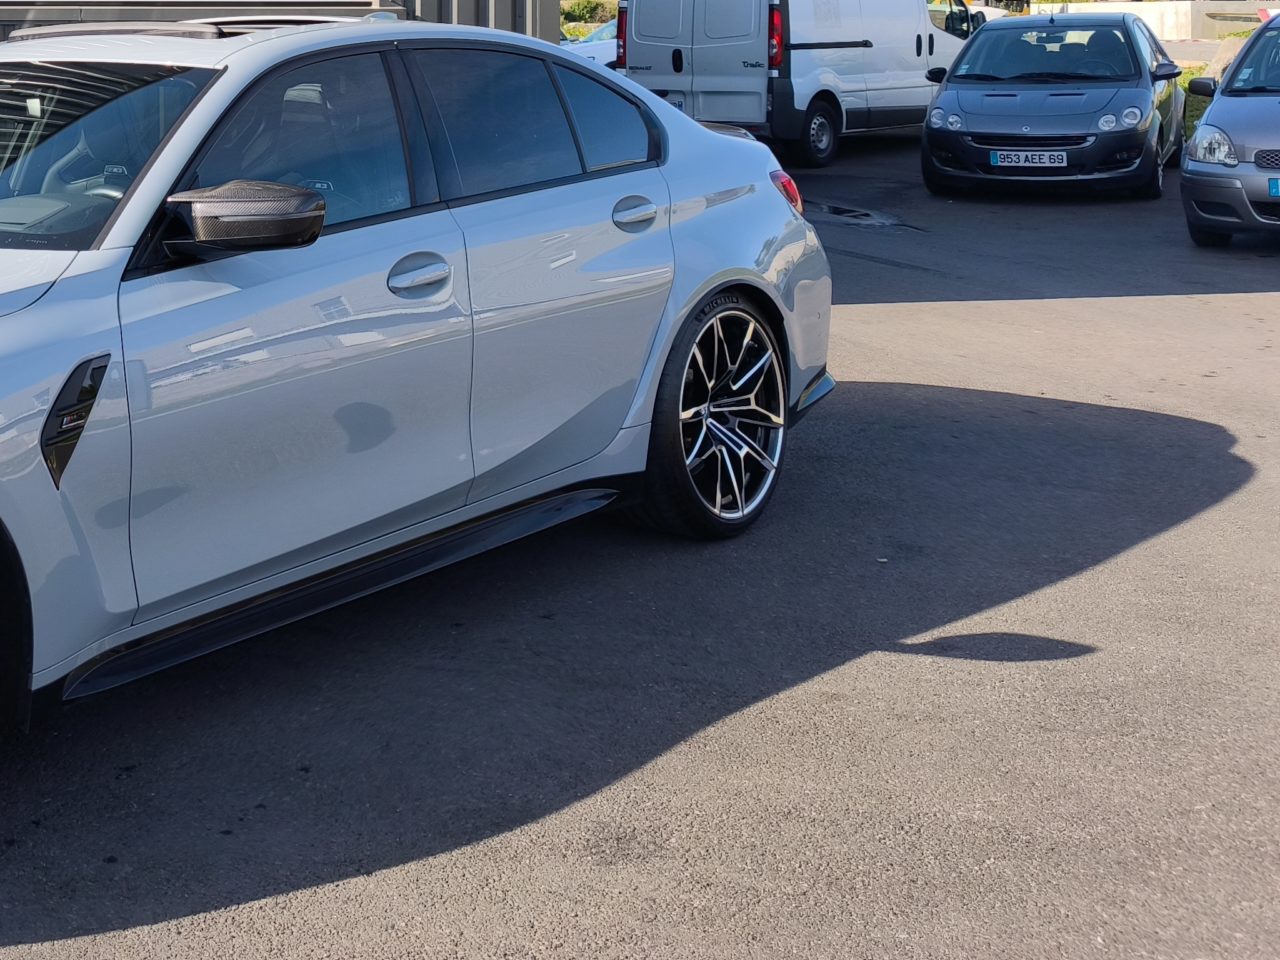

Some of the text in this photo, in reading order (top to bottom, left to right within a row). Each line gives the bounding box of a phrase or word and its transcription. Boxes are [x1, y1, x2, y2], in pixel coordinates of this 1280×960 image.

[999, 153, 1064, 164] 953 AEE 69
